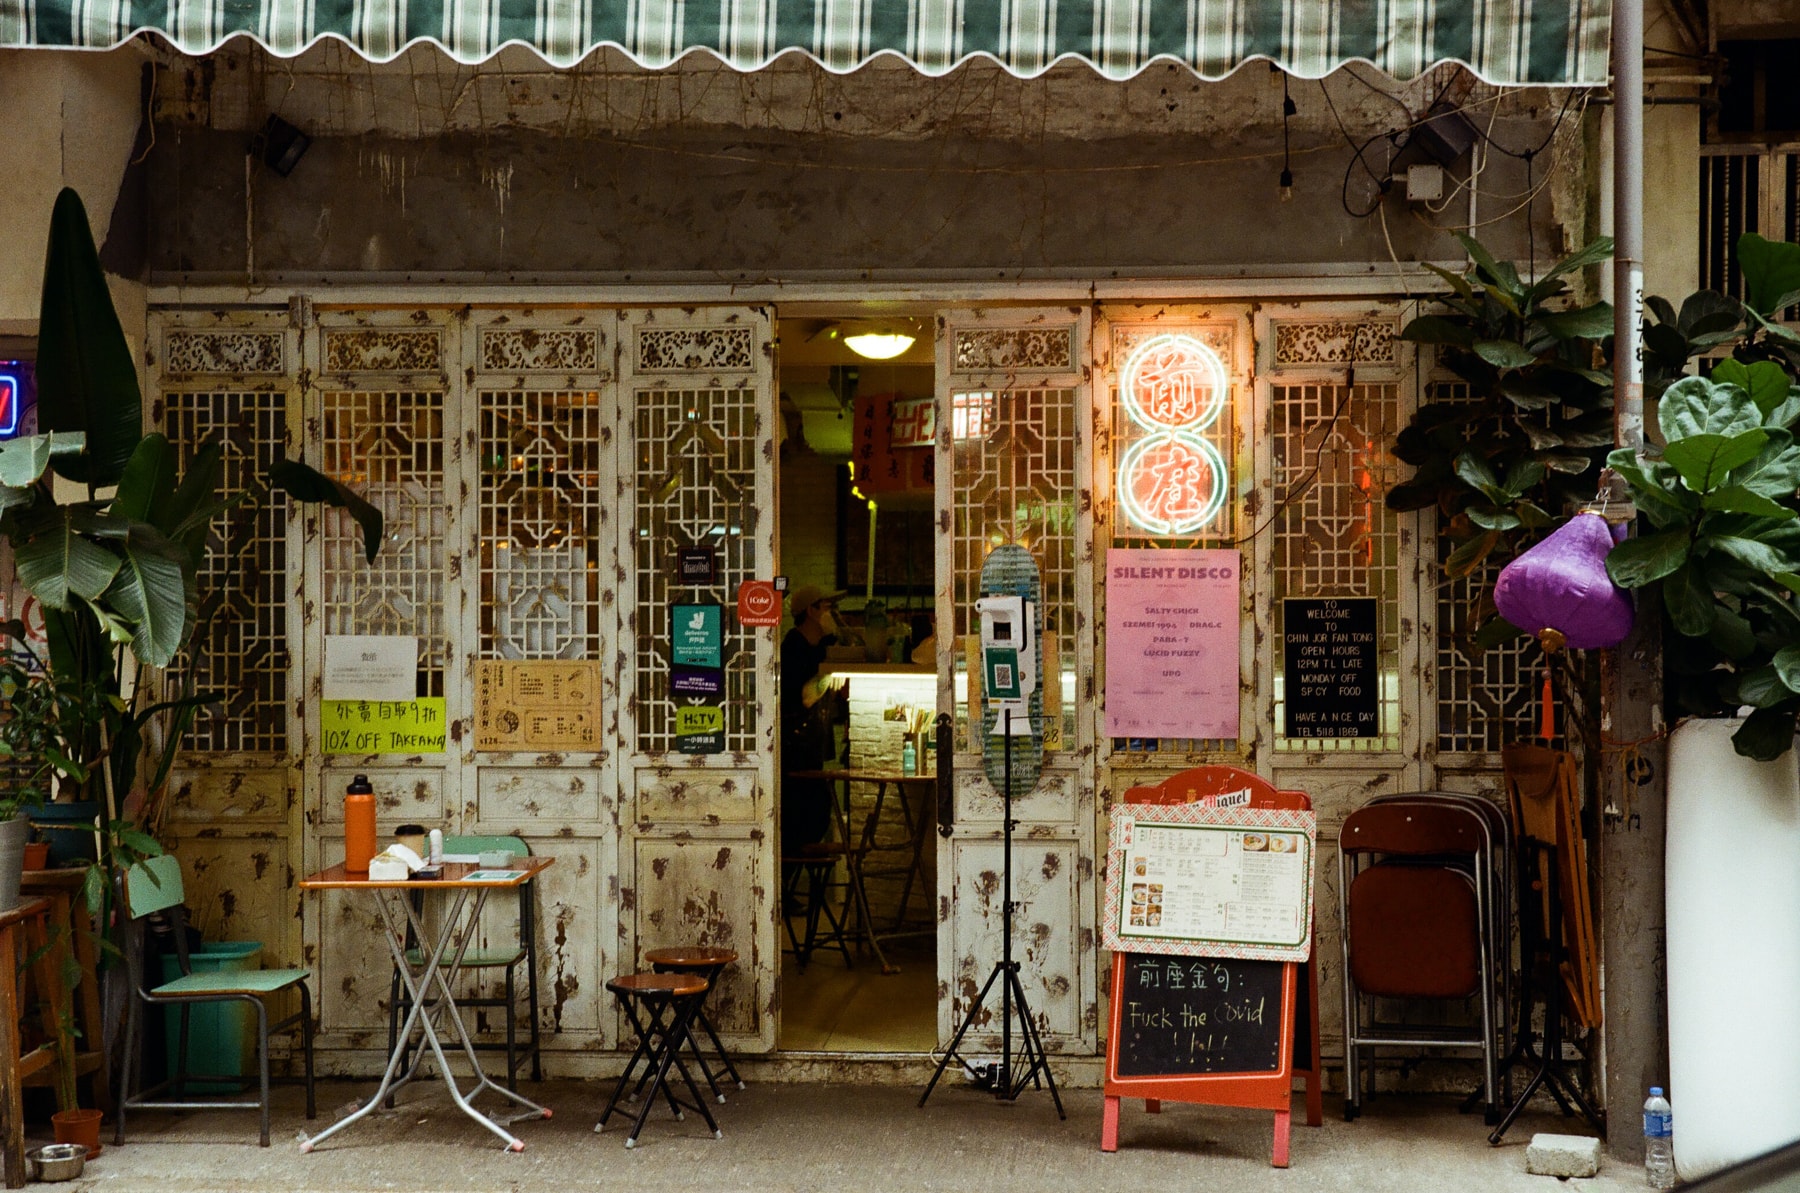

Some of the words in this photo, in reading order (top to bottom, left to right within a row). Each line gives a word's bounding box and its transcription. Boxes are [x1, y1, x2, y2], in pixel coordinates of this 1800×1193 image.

[1139, 355, 1204, 517] 前座
[1113, 567, 1175, 579] SILENT
[1178, 567, 1232, 579] DISCO
[1324, 600, 1338, 609] YO
[1145, 607, 1172, 615] SALTY
[1307, 609, 1351, 619] WELCOME
[1324, 622, 1338, 632] TO
[1287, 633, 1309, 643] CHIN
[1312, 633, 1328, 643] JOR
[1332, 633, 1349, 643] FAN
[1352, 633, 1373, 643] TONG
[1301, 646, 1326, 656] OPEN
[1332, 646, 1360, 656] HOURS
[1296, 659, 1319, 669] 12PM
[1342, 658, 1364, 668] LATE
[1301, 673, 1336, 684] MONDAY
[1340, 673, 1358, 683] OFF
[1339, 686, 1362, 696] FOOD
[1295, 712, 1317, 722] HAVE
[1320, 712, 1327, 722] A
[1358, 712, 1375, 722] DAY
[1296, 727, 1313, 737] TEL
[1316, 727, 1334, 737] 5118
[325, 729, 350, 752] 10%
[356, 731, 383, 750] OFF
[1128, 1001, 1174, 1029] Fuck
[1179, 1003, 1207, 1029] the
